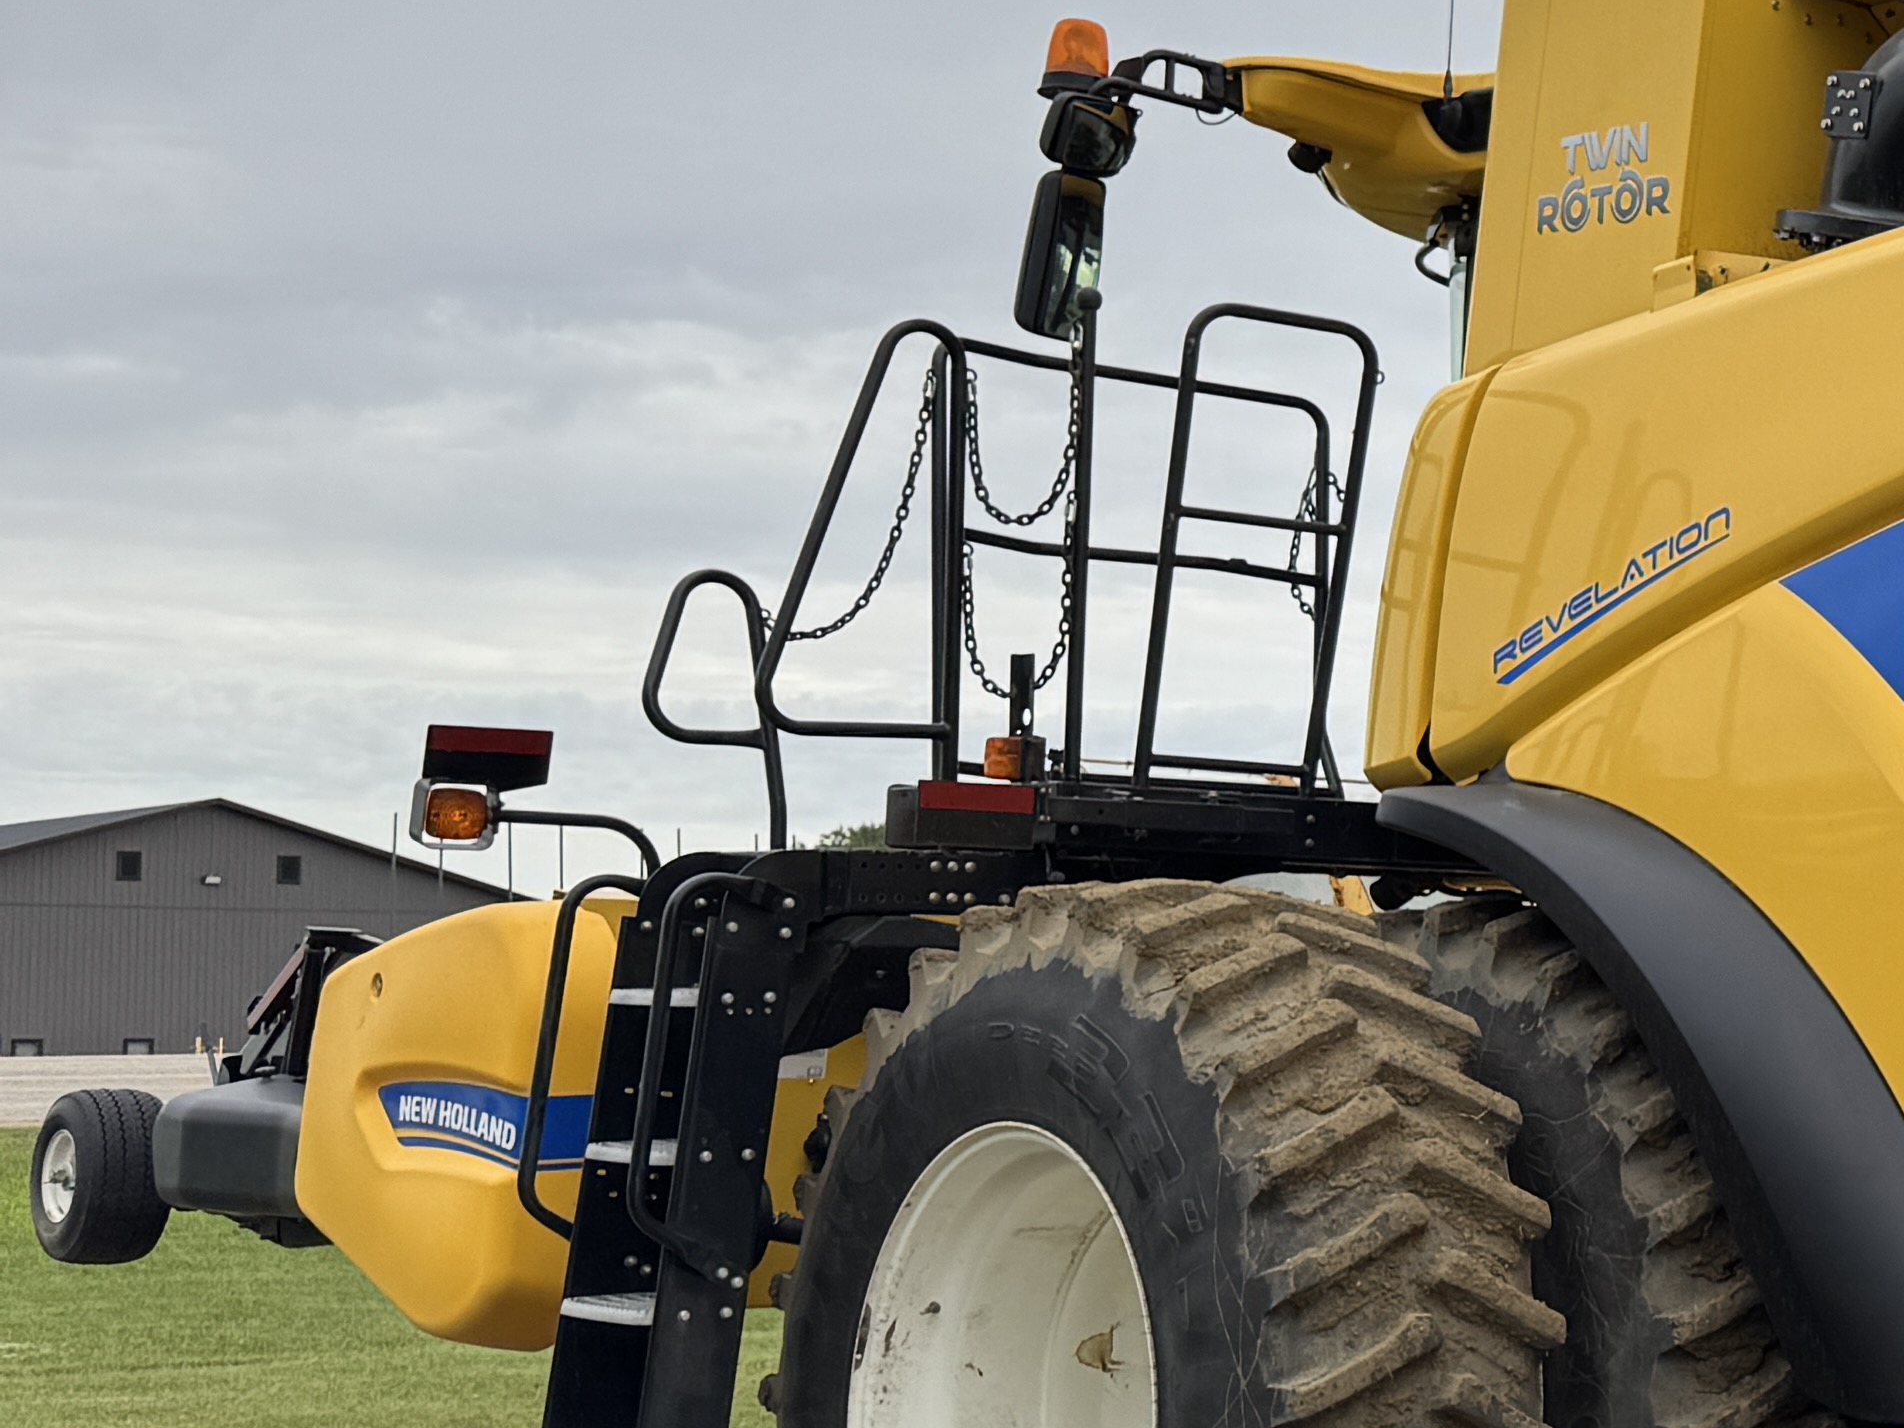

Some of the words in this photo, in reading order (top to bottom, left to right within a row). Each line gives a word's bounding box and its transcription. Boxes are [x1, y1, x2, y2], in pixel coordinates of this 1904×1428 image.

[1560, 121, 1648, 174] TWIN
[1537, 166, 1671, 236] ROTOR
[1493, 507, 1731, 674] REVELATION
[399, 1095, 437, 1125] NEW
[438, 1099, 516, 1151] HOLLAND
